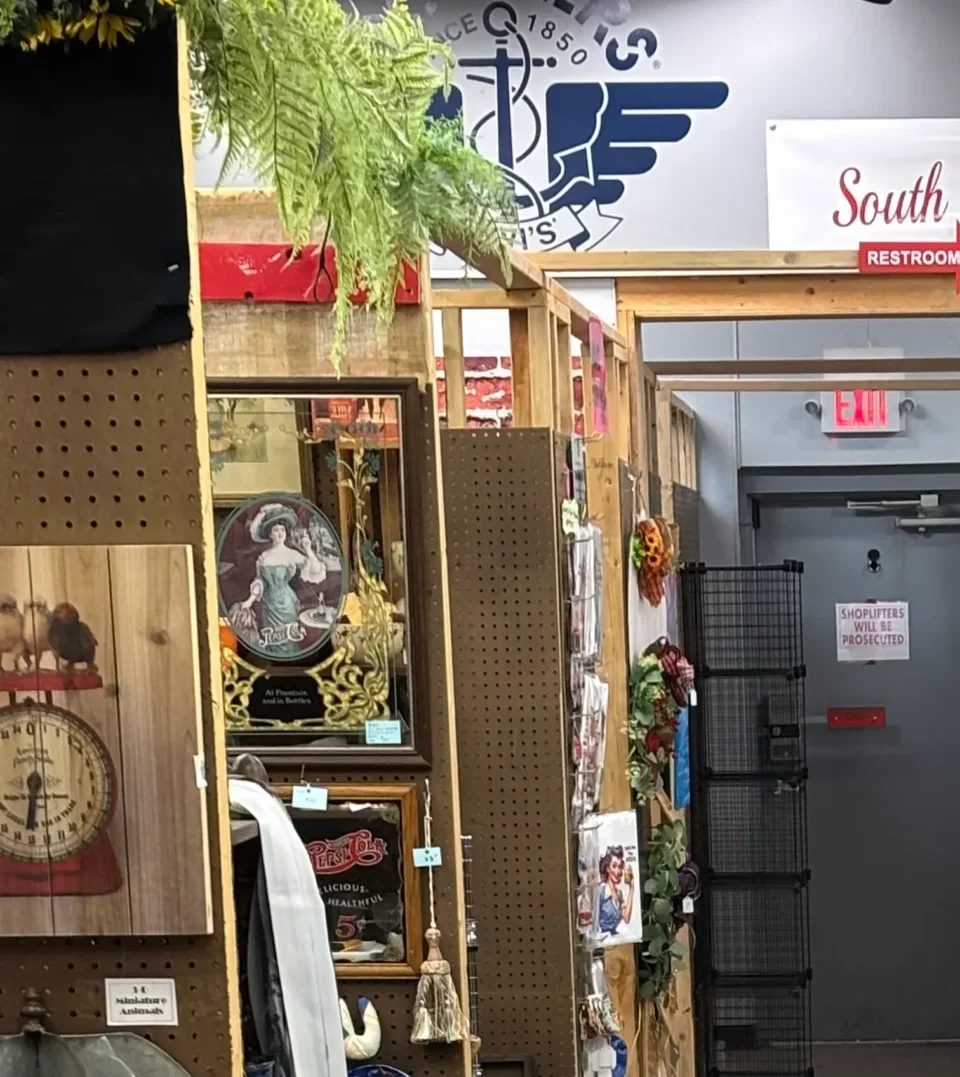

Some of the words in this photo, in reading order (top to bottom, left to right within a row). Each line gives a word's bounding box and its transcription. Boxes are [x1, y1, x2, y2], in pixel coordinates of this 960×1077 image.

[525, 14, 588, 66] 1850
[832, 160, 948, 228] South
[841, 607, 905, 621] SHOPLIFTERS
[854, 620, 878, 633] WILL
[880, 620, 893, 633] BE
[842, 633, 905, 646] PROSECUTED
[328, 895, 384, 908] HEALTHFUL
